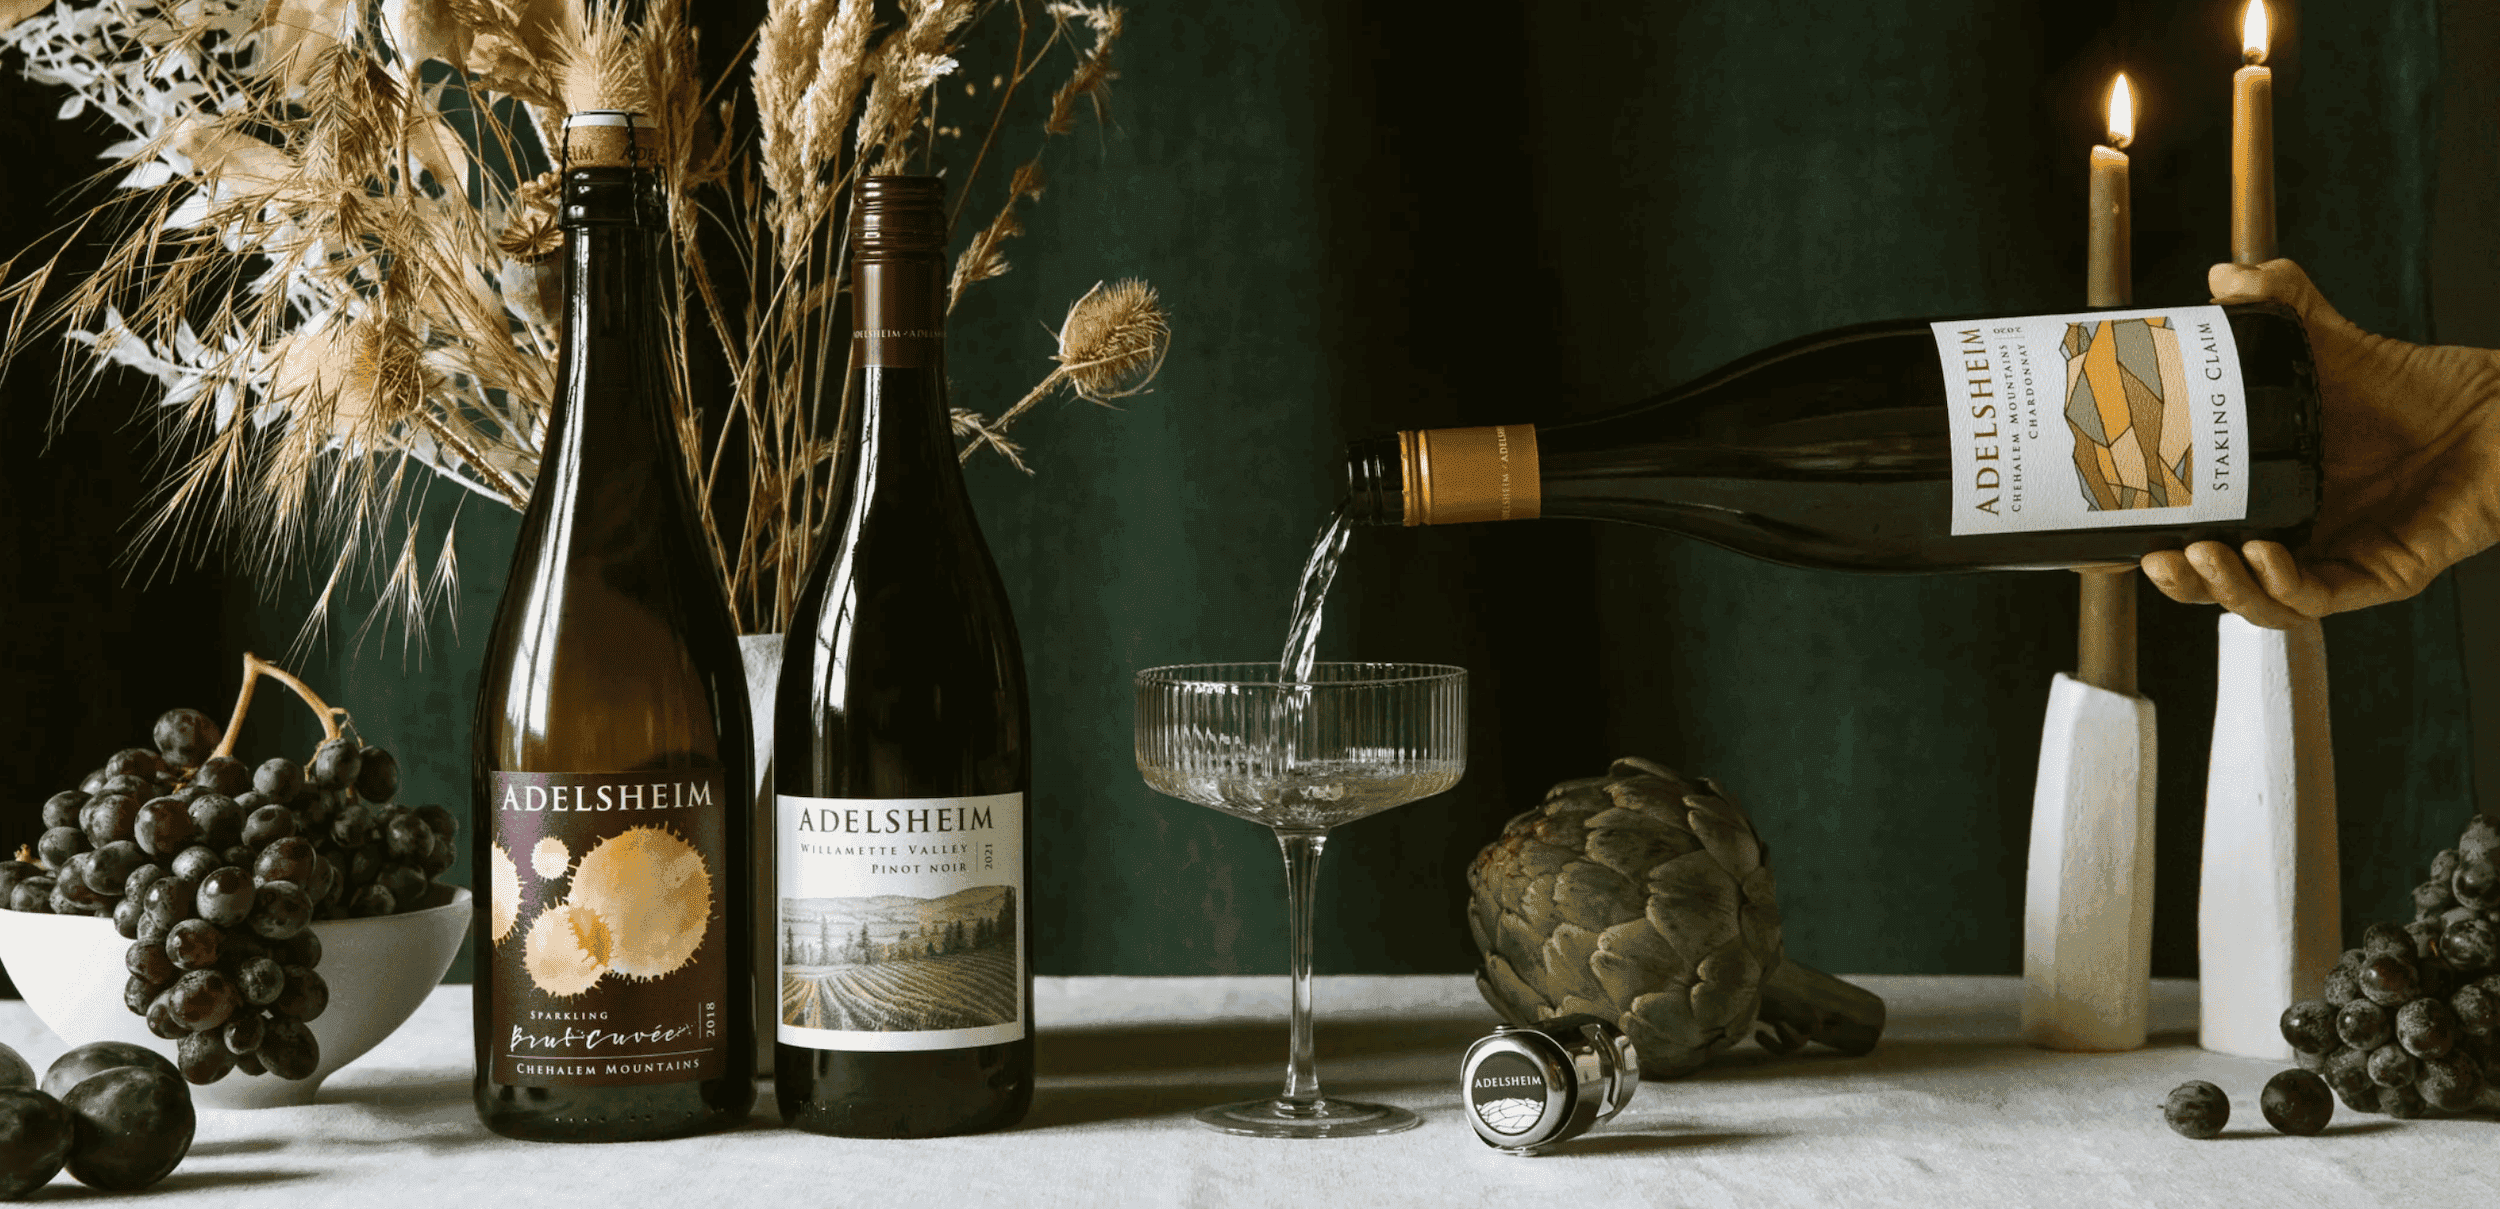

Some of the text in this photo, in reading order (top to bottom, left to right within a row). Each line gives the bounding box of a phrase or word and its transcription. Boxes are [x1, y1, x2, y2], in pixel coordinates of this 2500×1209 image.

[2017, 344, 2039, 440] CHARDONNAY
[2197, 323, 2230, 491] STAKING CLAIM
[1958, 328, 2000, 516] ADELSHEIM
[1999, 345, 2022, 512] CHEHALEM MOUNTAINS
[501, 780, 713, 812] ADELSHEIM
[799, 805, 995, 834] ADELSHEIM
[800, 843, 968, 856] WILLAMETTE VALLEY
[984, 843, 993, 871] 2021
[872, 862, 967, 874] PINOT NOIR
[530, 1010, 608, 1020] SPARKLING
[705, 1001, 716, 1038] 2018
[510, 1024, 688, 1052] Brut Cuvée
[516, 1058, 700, 1076] CHEHALEM MOUNTAINS
[1475, 1075, 1542, 1088] ADELSHEIM
